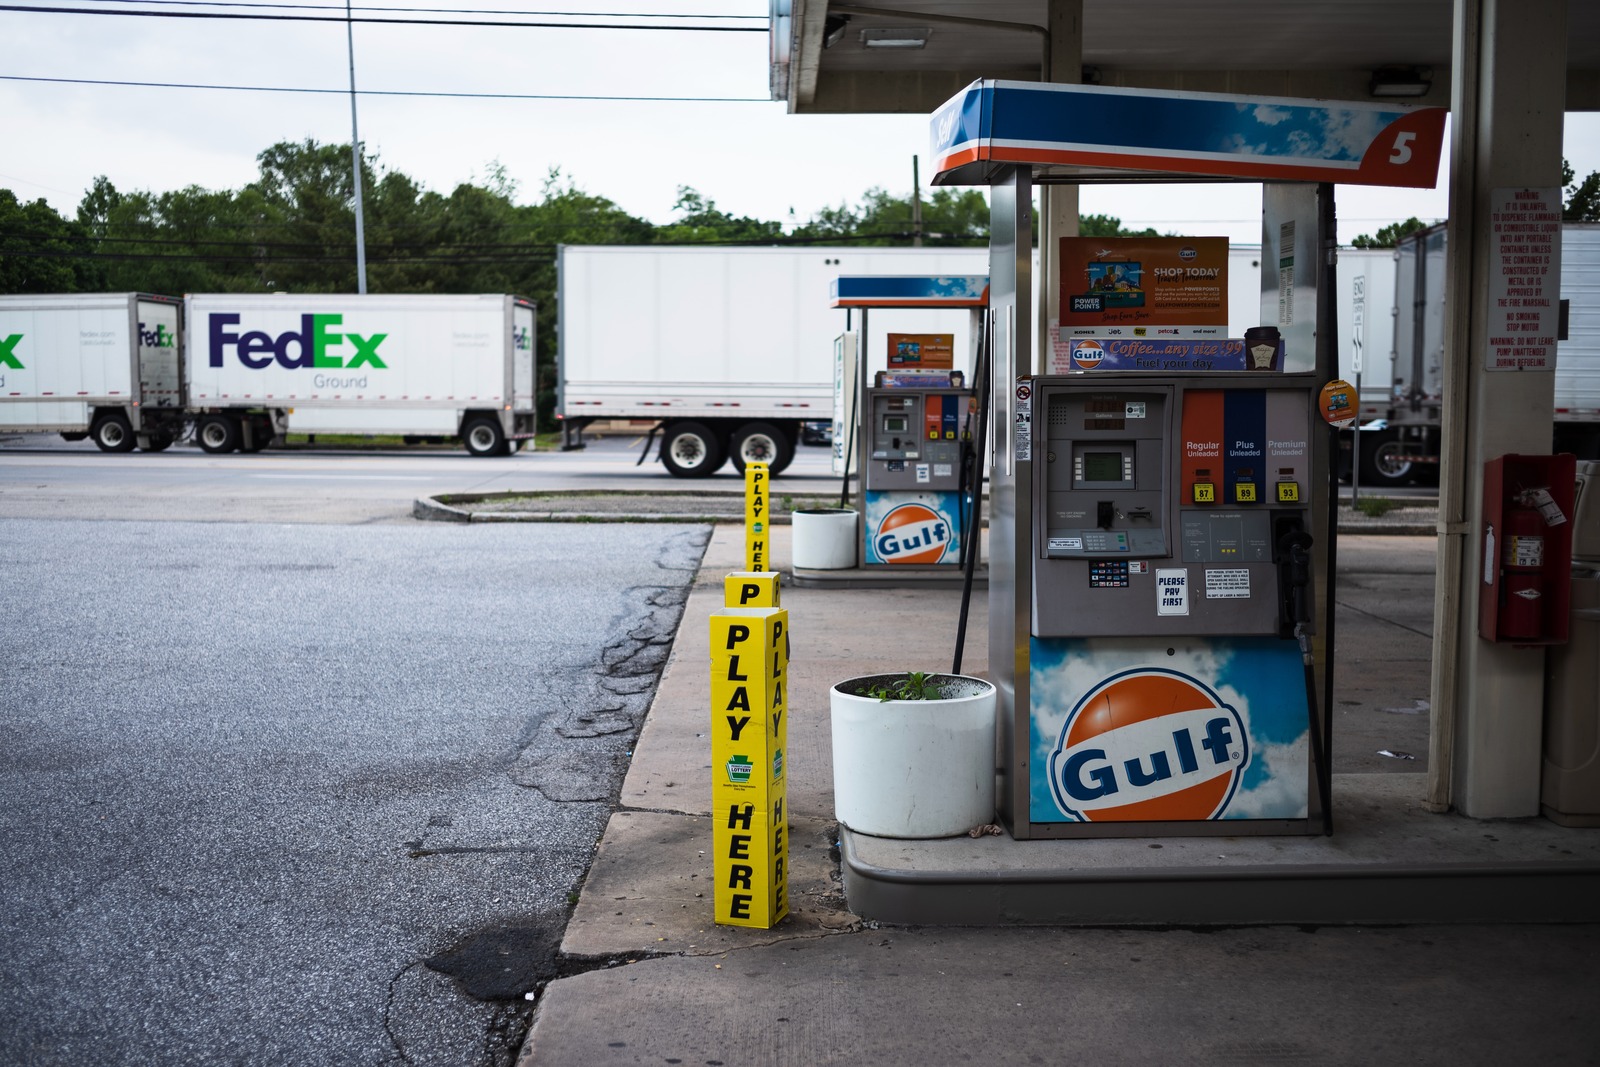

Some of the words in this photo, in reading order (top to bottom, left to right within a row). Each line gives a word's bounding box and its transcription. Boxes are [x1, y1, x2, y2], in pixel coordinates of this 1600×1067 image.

[1389, 131, 1416, 164] 5
[1514, 192, 1539, 200] WARNING
[1506, 202, 1510, 210] IT
[1512, 202, 1517, 210] IS
[1520, 202, 1547, 210] UNLAWFUL
[1495, 224, 1501, 232] OR
[1504, 224, 1539, 232] COMBUSTIBLE
[1542, 224, 1558, 232] LIQUID
[1502, 256, 1511, 264] THE
[1514, 256, 1542, 264] CONTAINER
[1544, 256, 1549, 264] IS
[1154, 268, 1182, 276] SHOP
[1186, 268, 1220, 276] TODAY
[1156, 273, 1178, 284] Travel
[1182, 273, 1216, 282] Tomorrow
[138, 323, 174, 348] FedEx
[209, 314, 388, 370] FedEx
[1074, 349, 1104, 359] Gulf
[1194, 341, 1218, 354] size
[1136, 358, 1160, 367] Fuel
[1163, 360, 1190, 369] your
[314, 374, 368, 388] Ground
[1187, 442, 1219, 451] Regular
[1268, 440, 1306, 448] Premium
[754, 474, 763, 517] PLAY
[878, 523, 944, 555] Gulf
[753, 542, 763, 572] HER
[1159, 577, 1185, 586] PLEASE
[1163, 598, 1182, 606] FIRST
[726, 625, 751, 741] PLAY
[773, 620, 782, 737] PLAY
[1062, 718, 1233, 801] Gulf
[728, 805, 753, 919] HERE
[774, 797, 783, 915] HERE
